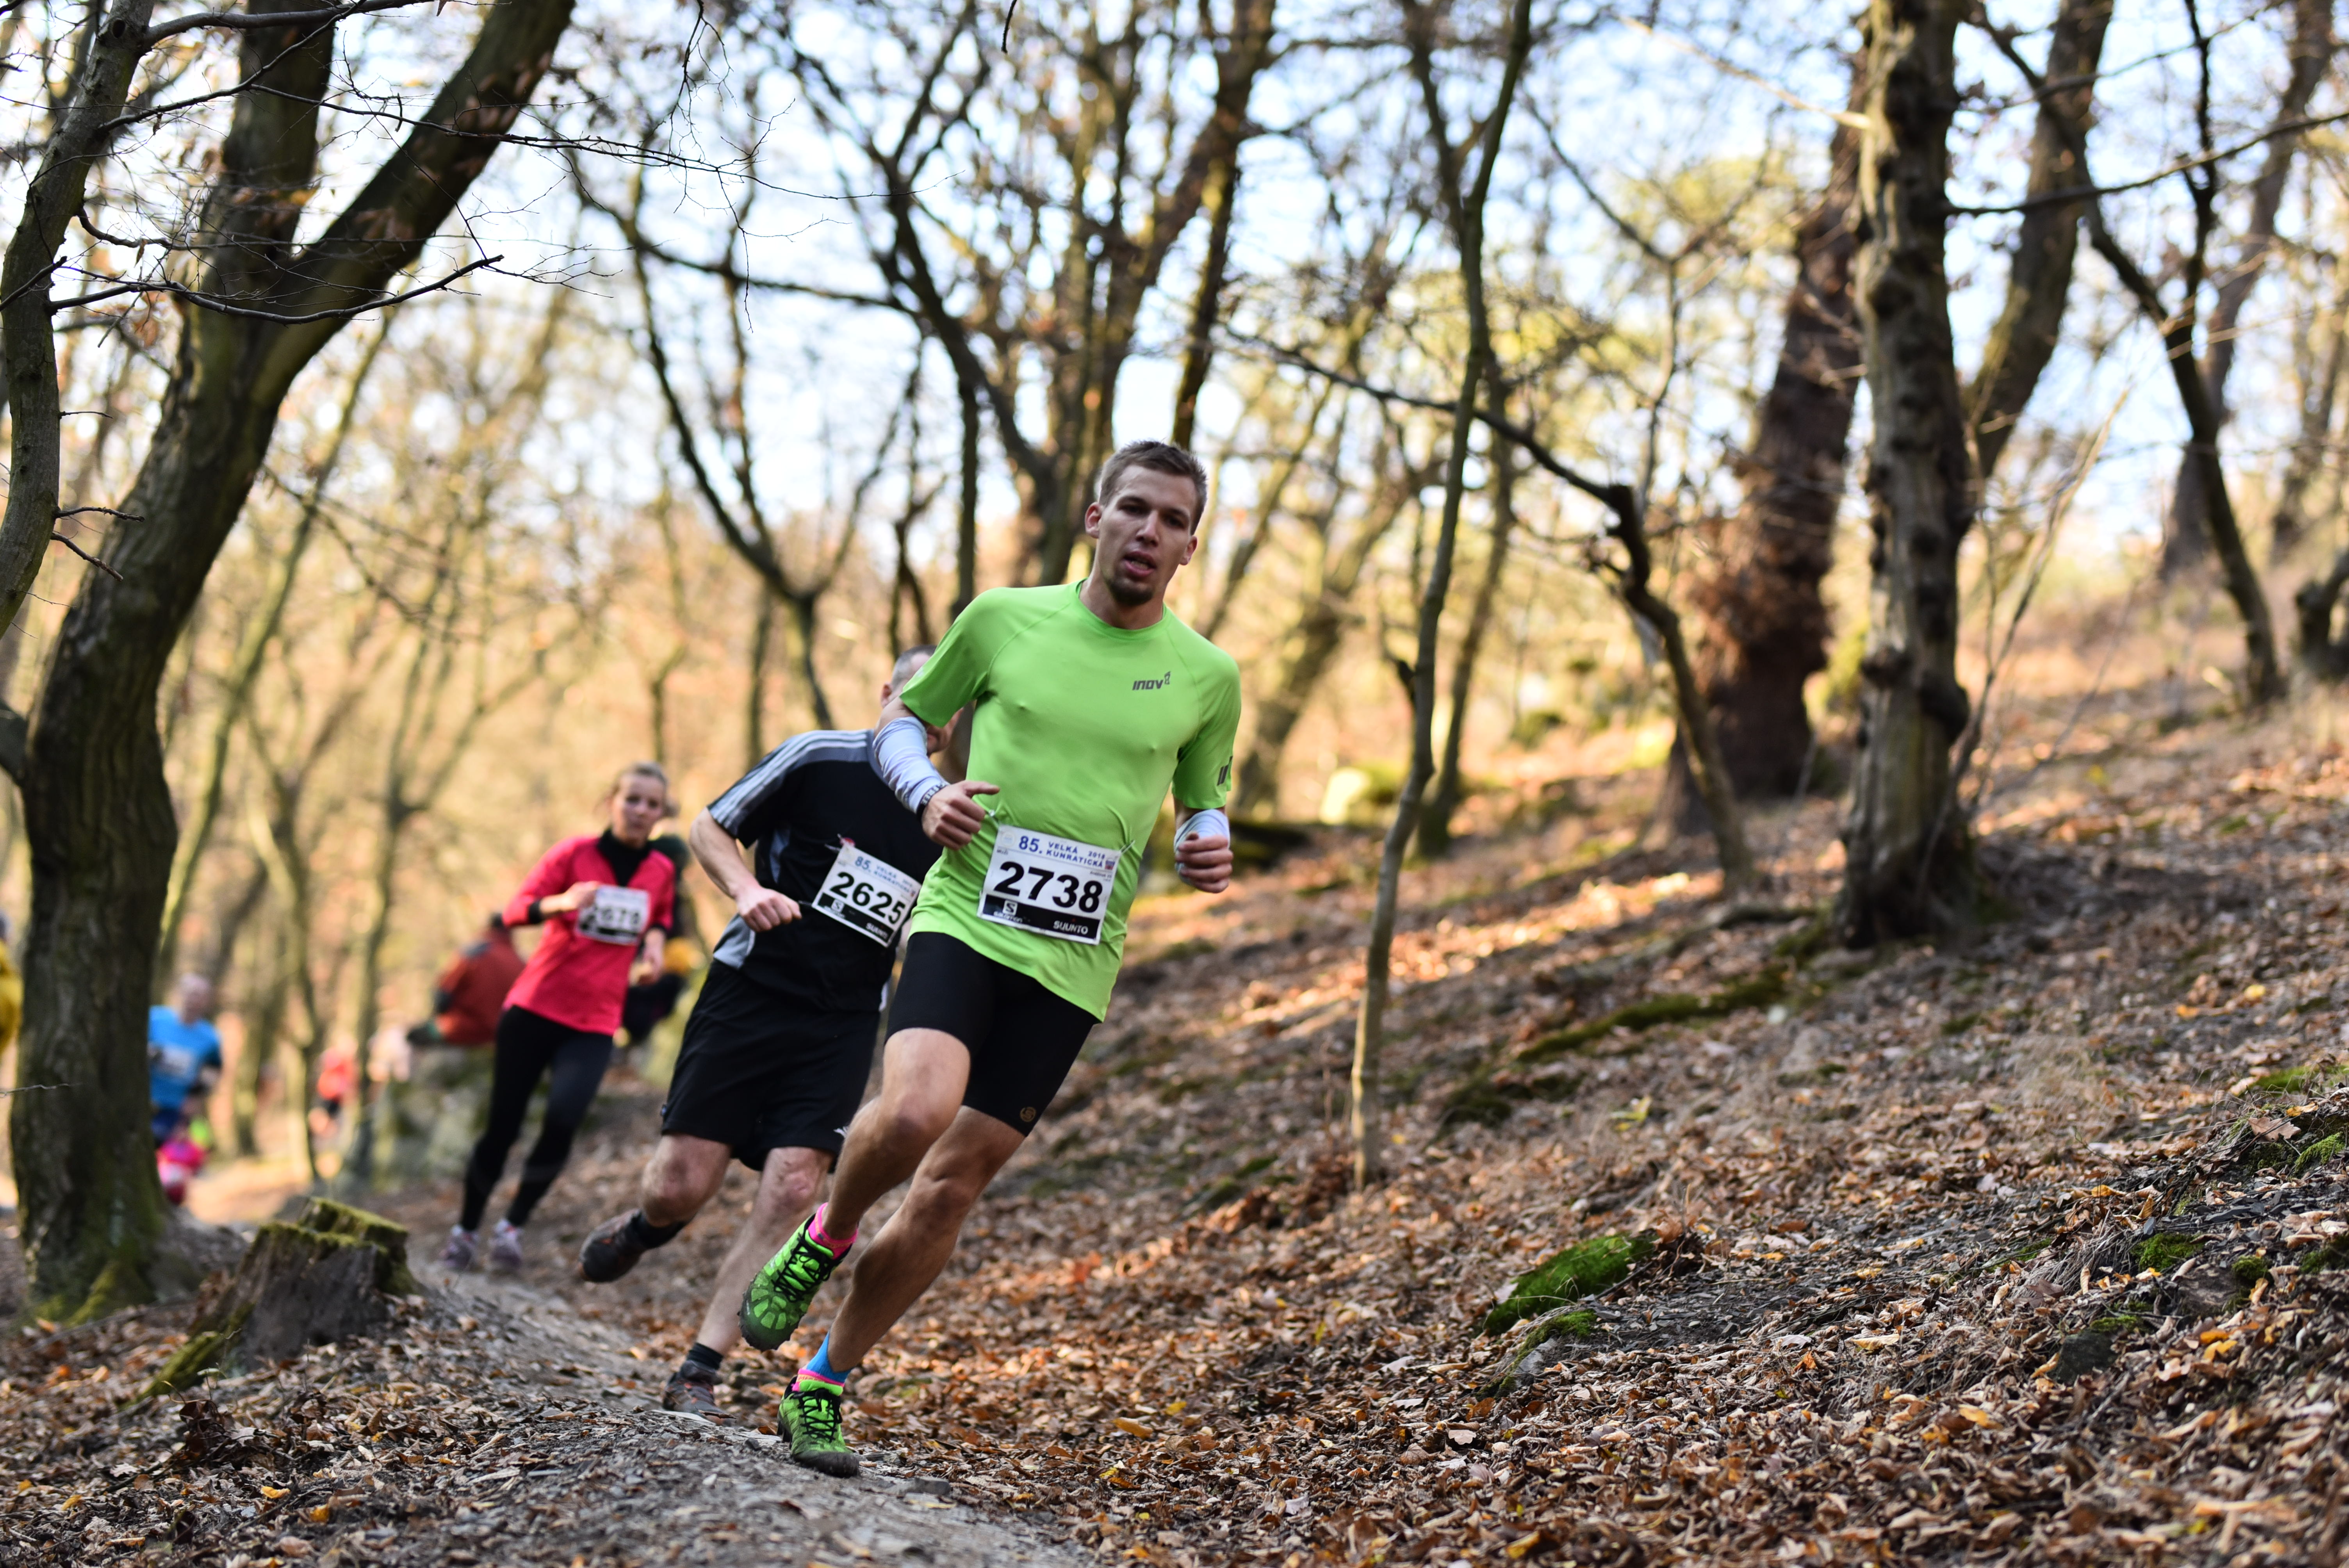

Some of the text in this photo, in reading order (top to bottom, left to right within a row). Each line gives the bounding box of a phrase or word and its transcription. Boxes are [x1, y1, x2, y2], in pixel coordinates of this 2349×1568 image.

[1019, 836, 1042, 853] 85.
[1049, 841, 1078, 853] VELKÁ
[829, 872, 905, 925] 2625
[993, 861, 1103, 913] 2738
[1053, 920, 1089, 935] SUUNTO
